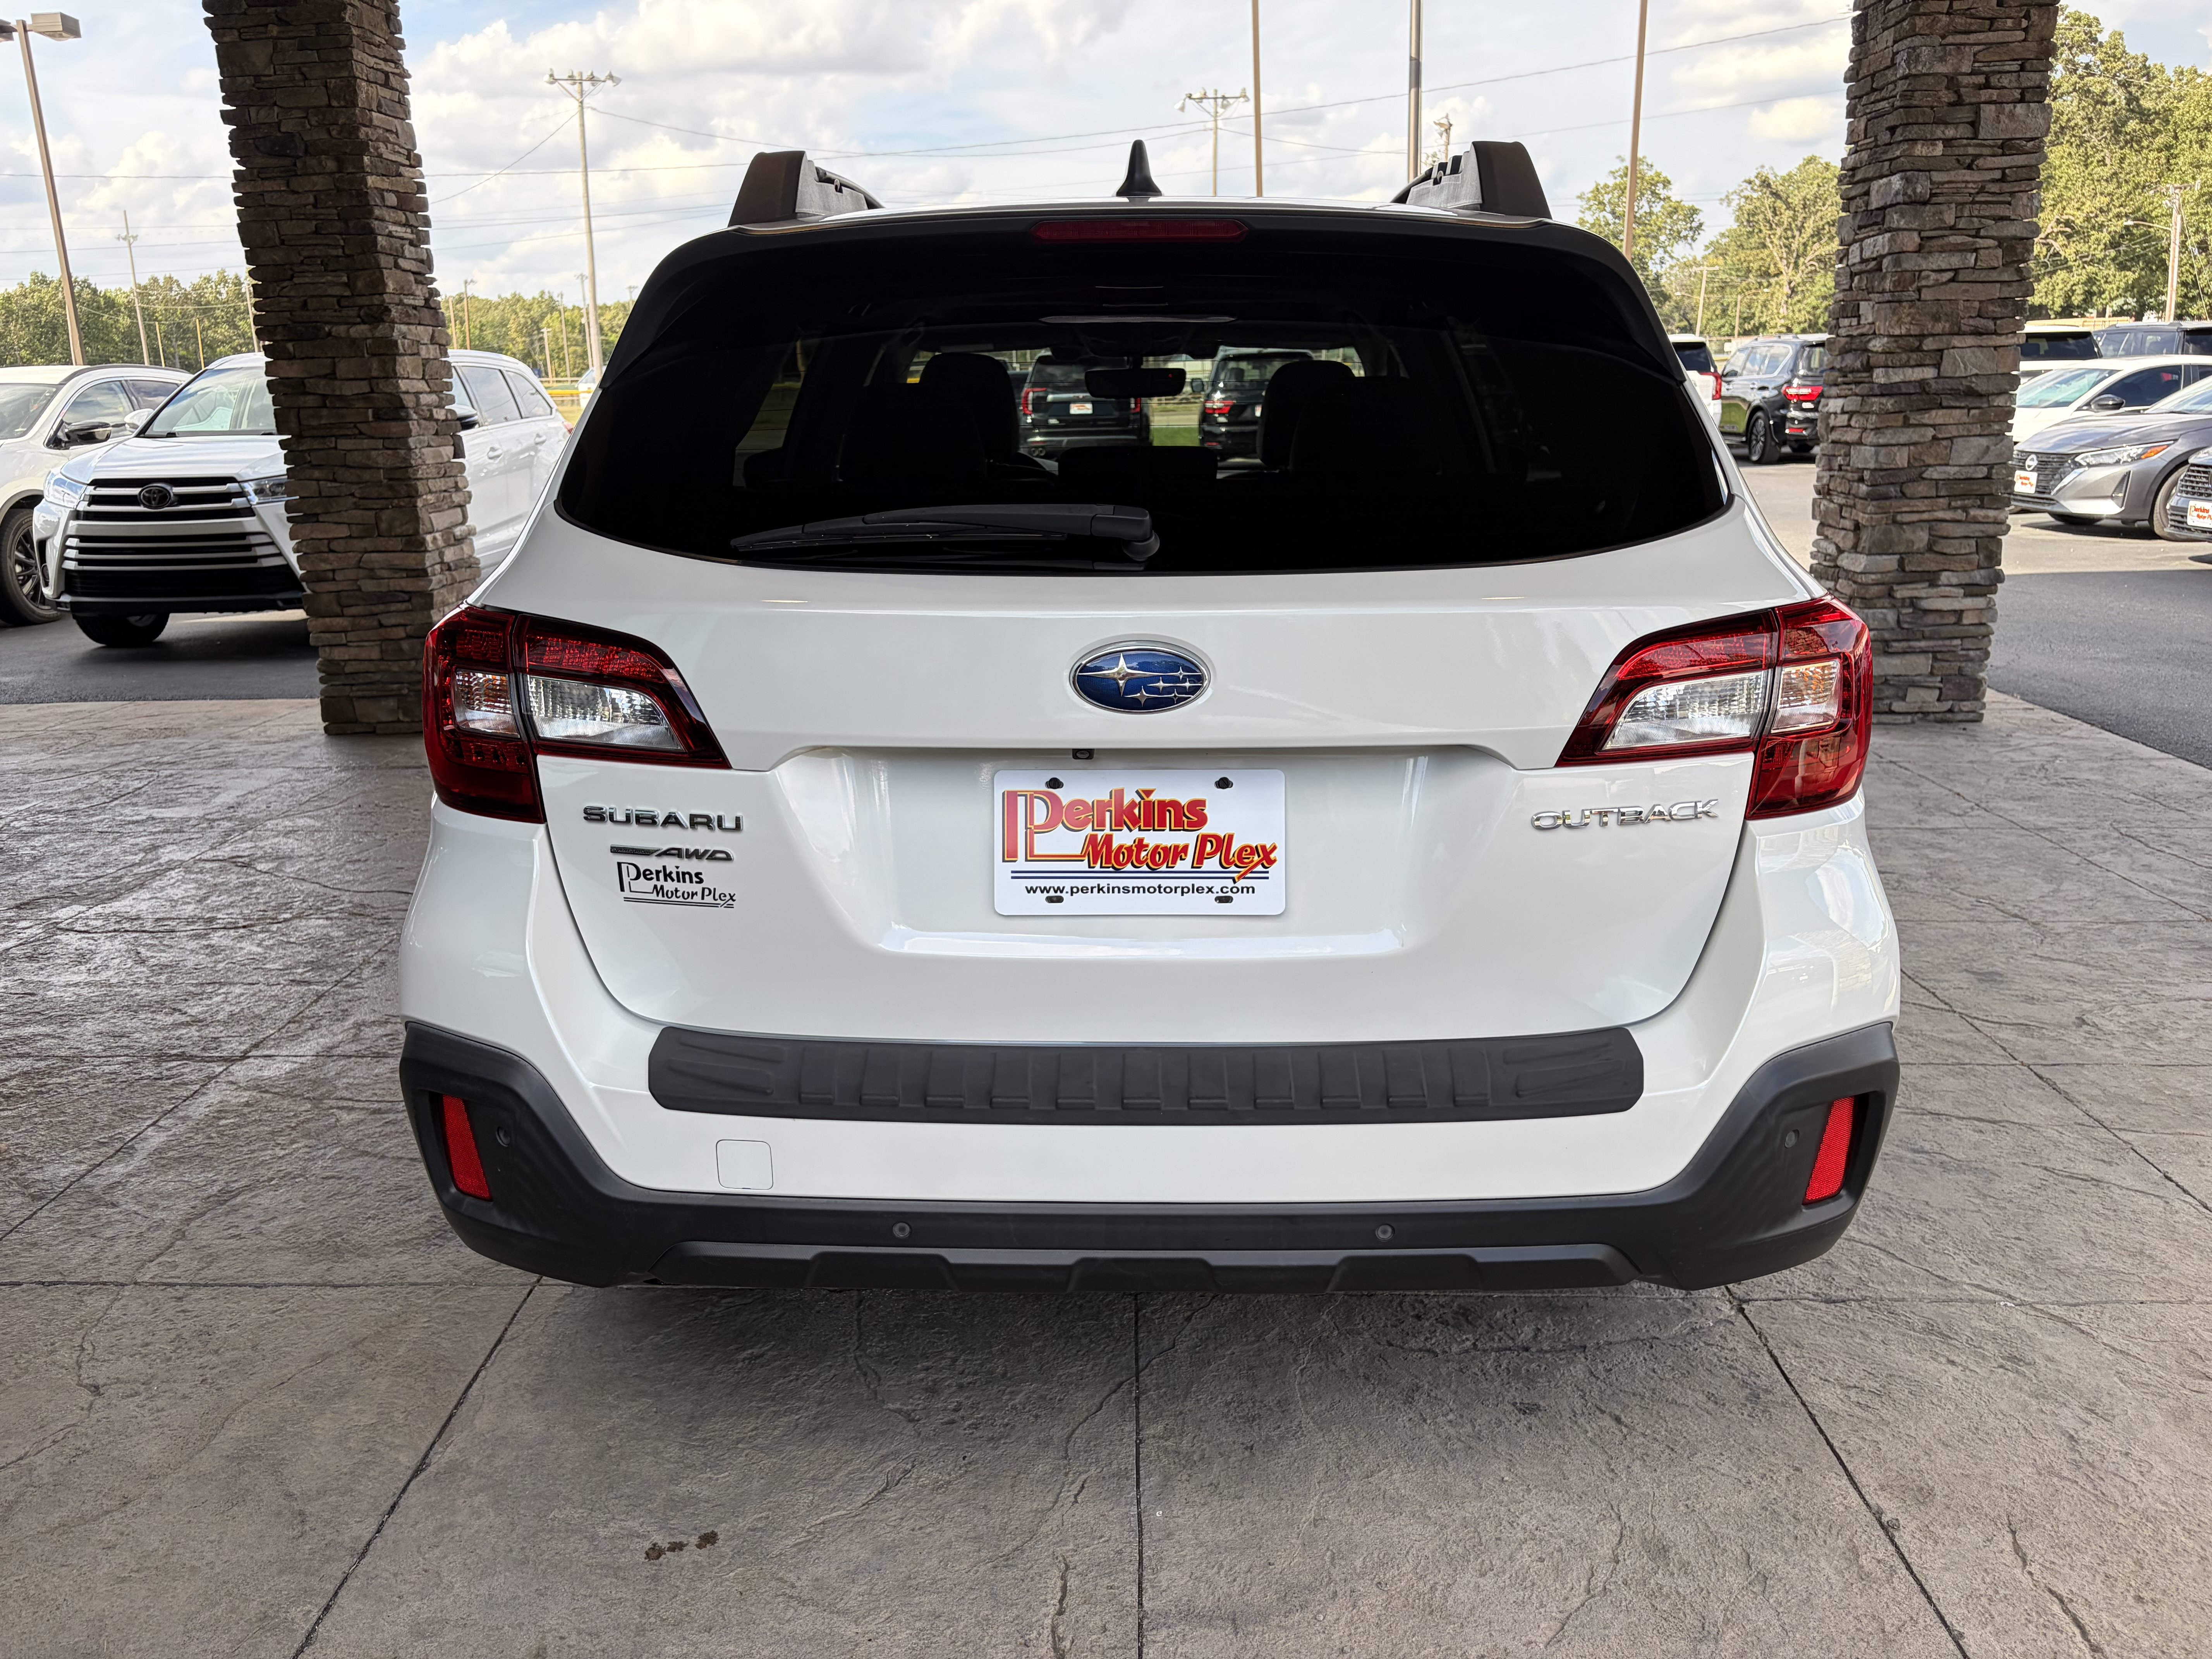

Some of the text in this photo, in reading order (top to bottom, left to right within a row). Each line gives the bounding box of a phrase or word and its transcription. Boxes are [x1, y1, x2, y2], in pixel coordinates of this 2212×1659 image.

[583, 805, 744, 831] SUBARU
[1002, 788, 1209, 862] Perkins
[1531, 799, 1718, 831] OUTBACK
[654, 847, 734, 861] AWD
[1084, 832, 1279, 883] Motor Plex
[617, 861, 704, 892] Perkins
[1025, 883, 1255, 896] www.perkinsmotorplex.com
[652, 884, 737, 907] Motor Plex
